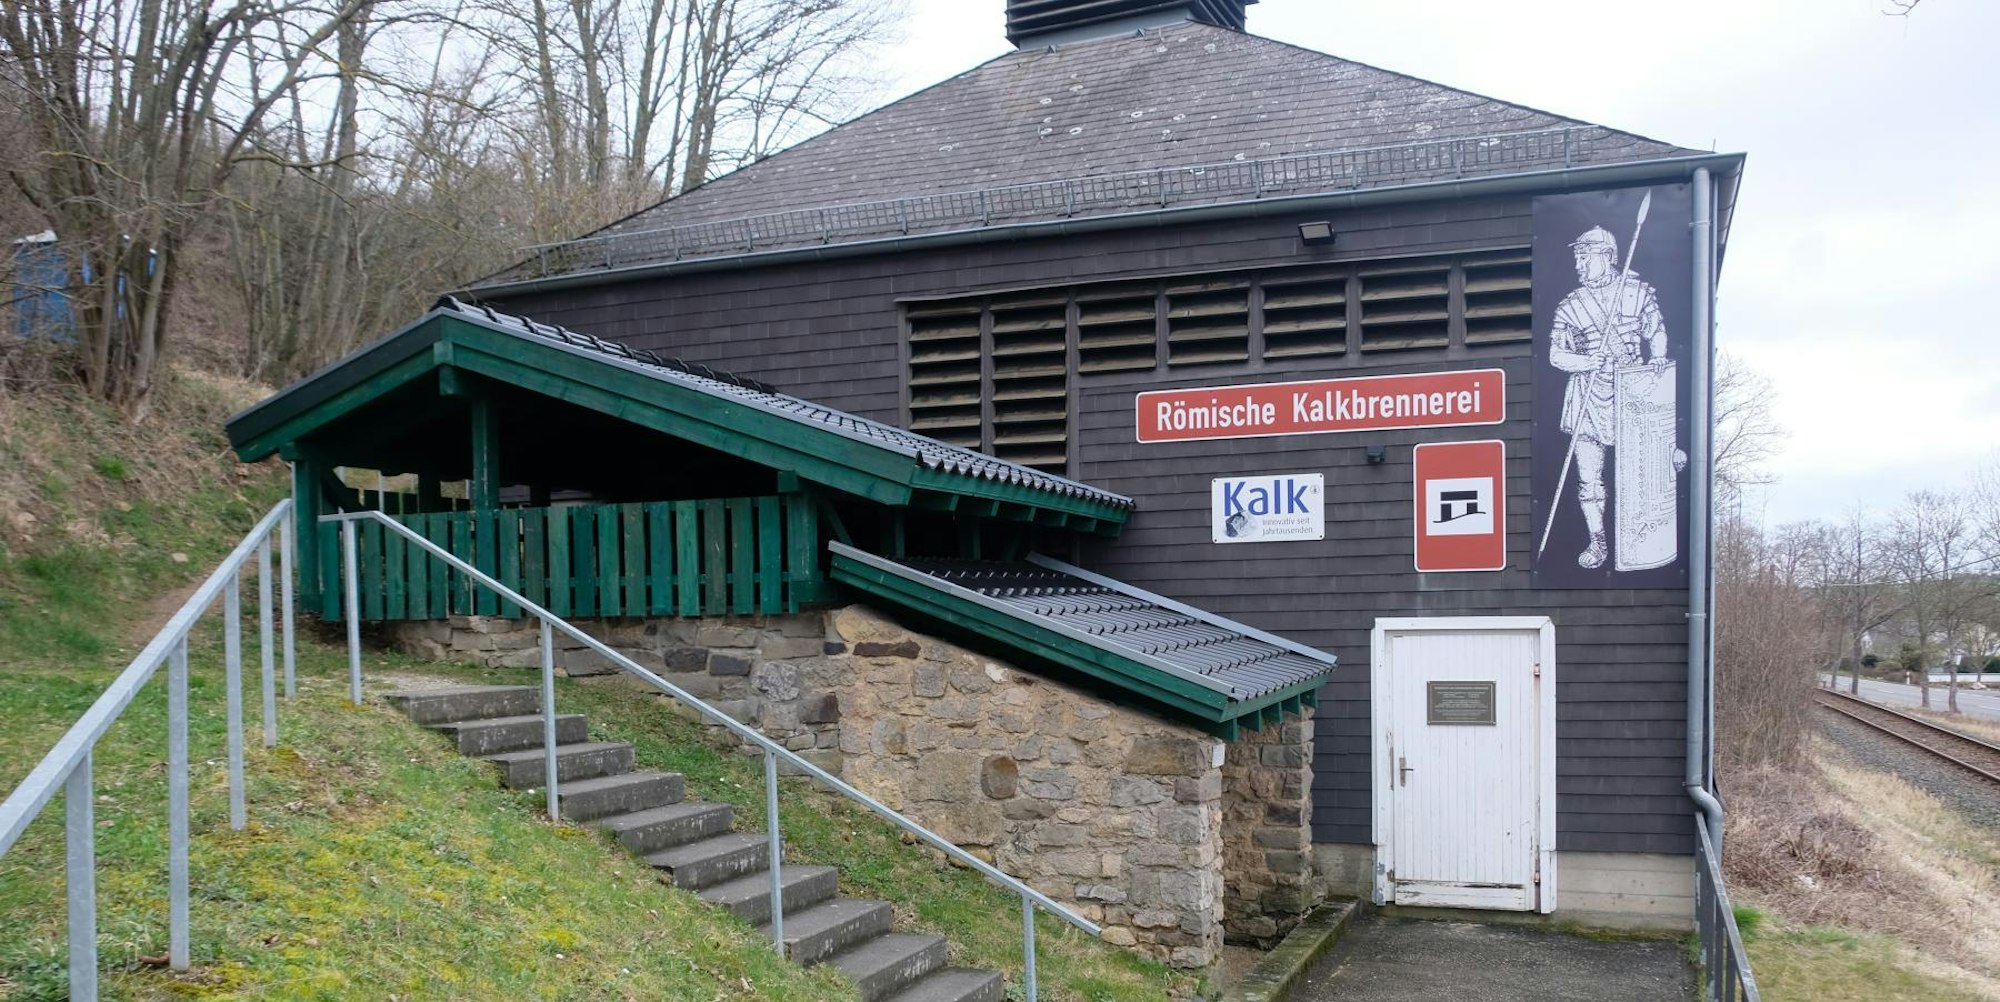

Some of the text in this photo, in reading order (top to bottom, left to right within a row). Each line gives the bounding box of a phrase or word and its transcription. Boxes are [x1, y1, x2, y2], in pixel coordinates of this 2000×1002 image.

[1157, 382, 1480, 431] Römische Kalkbrennerei
[1224, 479, 1309, 516] Kalk
[1297, 517, 1310, 525] seit
